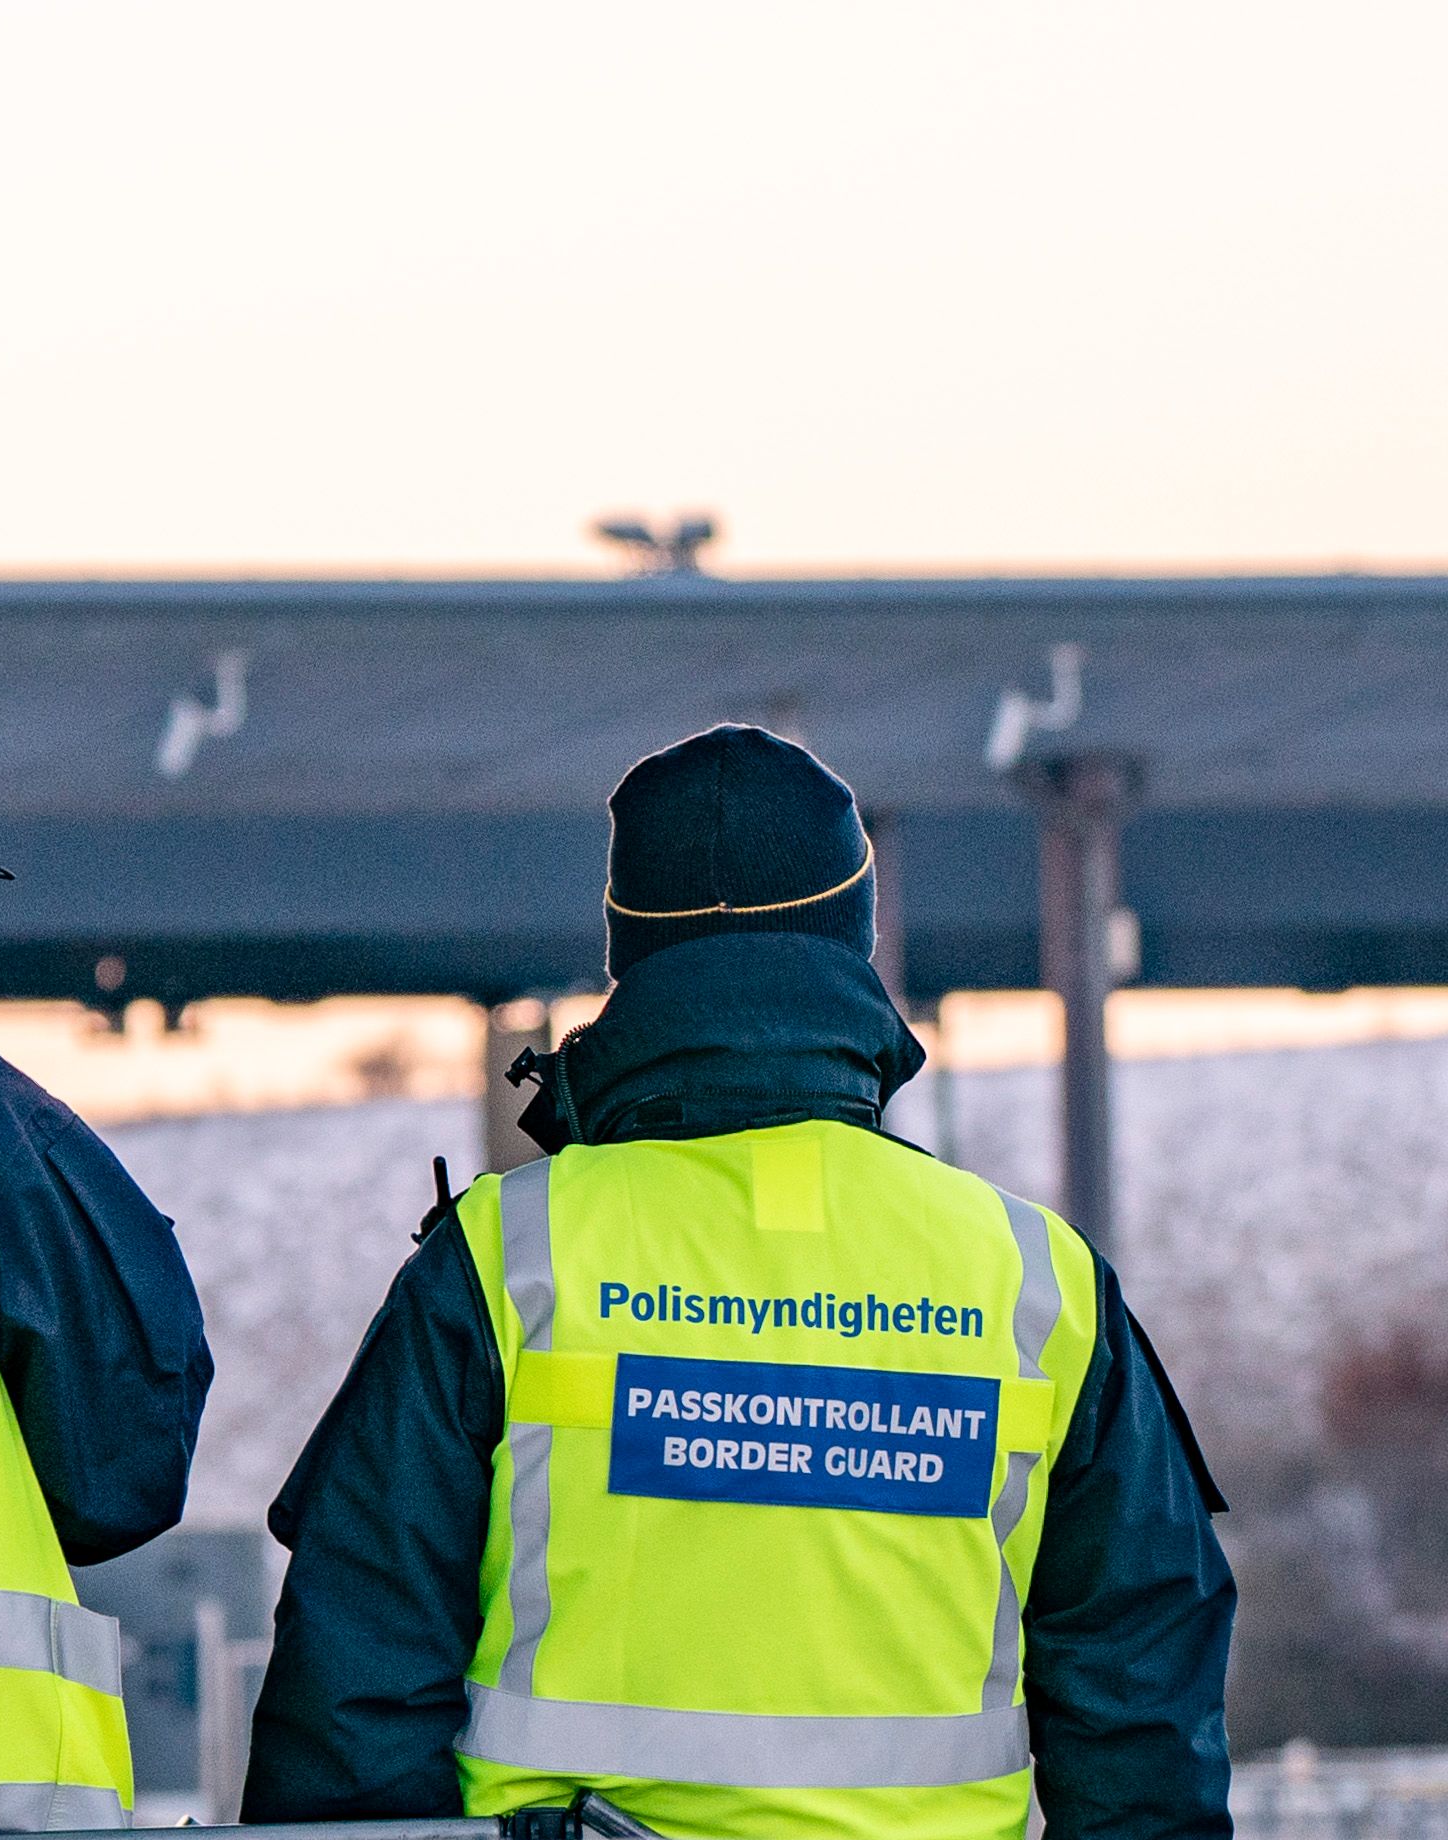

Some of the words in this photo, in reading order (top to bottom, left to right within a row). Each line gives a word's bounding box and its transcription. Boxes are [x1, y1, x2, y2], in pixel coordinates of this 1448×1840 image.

[599, 1282, 984, 1338] Polismyndigheten
[628, 1387, 986, 1440] PASSKONTROLLANT
[662, 1436, 812, 1474] BORDER
[824, 1447, 944, 1484] GUARD
